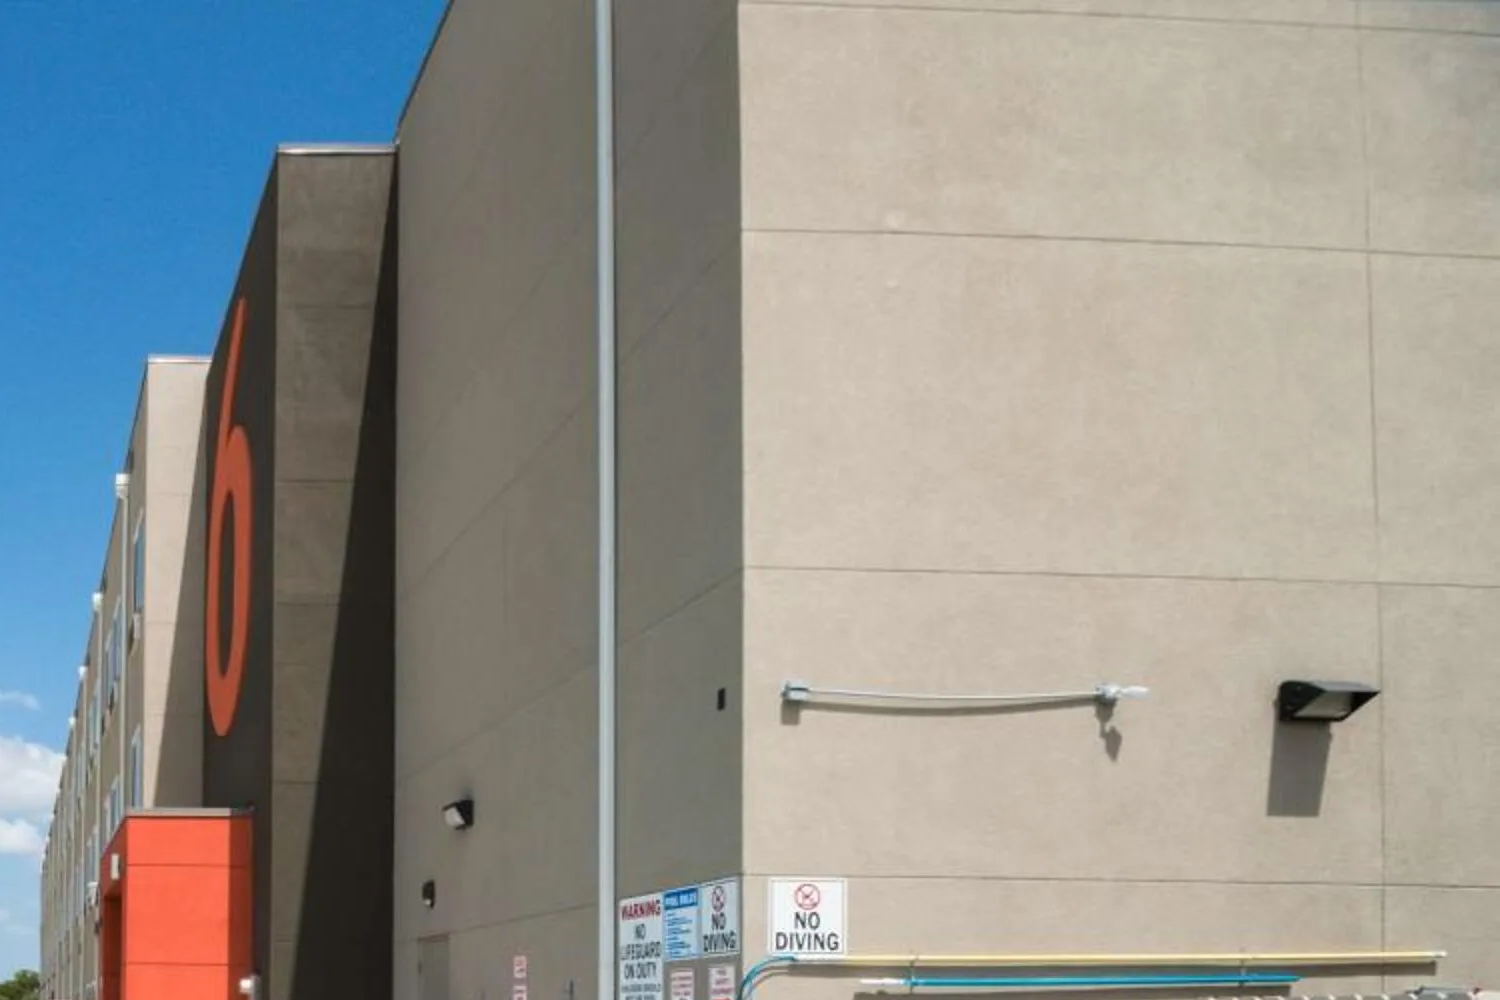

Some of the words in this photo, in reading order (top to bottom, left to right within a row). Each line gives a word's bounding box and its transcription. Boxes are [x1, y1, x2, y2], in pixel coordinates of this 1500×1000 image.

[206, 297, 253, 737] 6
[621, 899, 661, 921] WARNING
[711, 912, 726, 930] NO
[794, 911, 821, 930] NO
[634, 923, 646, 940] NO
[703, 929, 737, 952] DIVING
[775, 931, 839, 951] DIVING
[620, 941, 661, 960] LIFEGUARD
